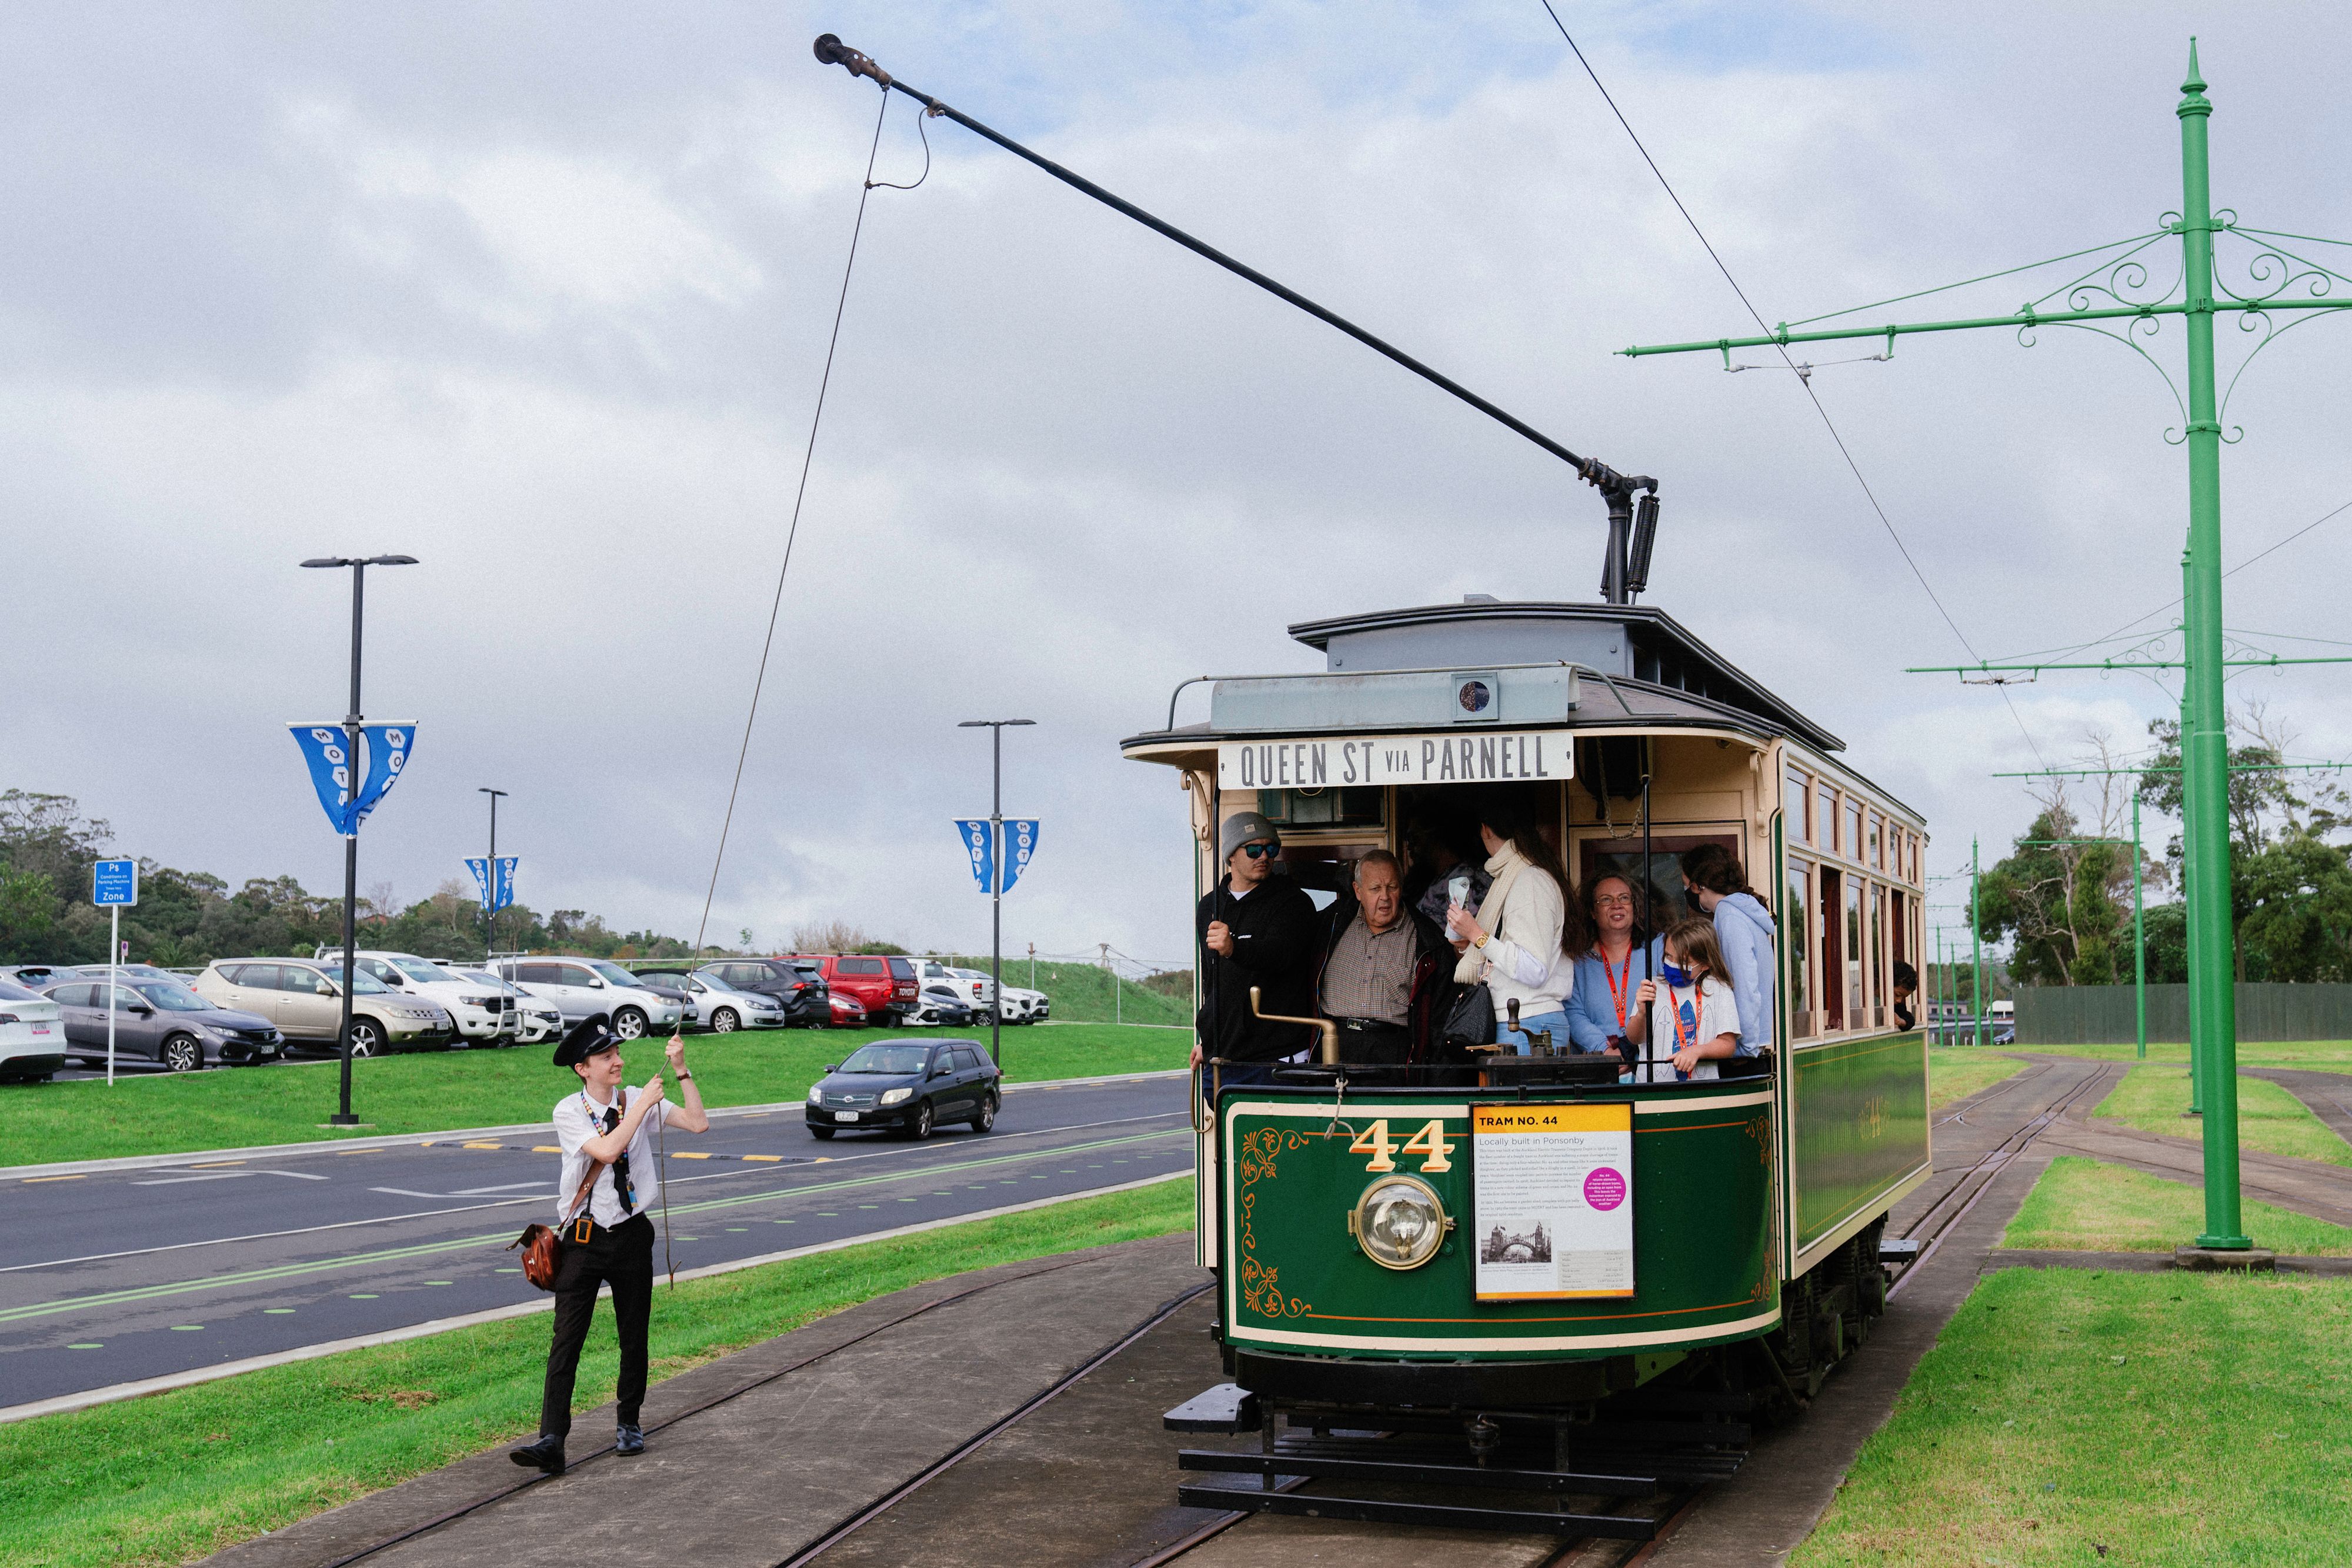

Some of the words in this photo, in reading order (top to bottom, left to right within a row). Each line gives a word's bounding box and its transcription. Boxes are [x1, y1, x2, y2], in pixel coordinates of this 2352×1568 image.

[1240, 743, 1326, 786] QUEEN
[1343, 742, 1374, 783] ST
[1385, 750, 1410, 772] VIA
[1422, 735, 1548, 780] PARNELL
[103, 892, 124, 901] Zone
[1479, 1117, 1513, 1126] TRAM
[1517, 1117, 1538, 1125] NO.
[1543, 1116, 1558, 1125] 44
[1349, 1120, 1455, 1172] 44
